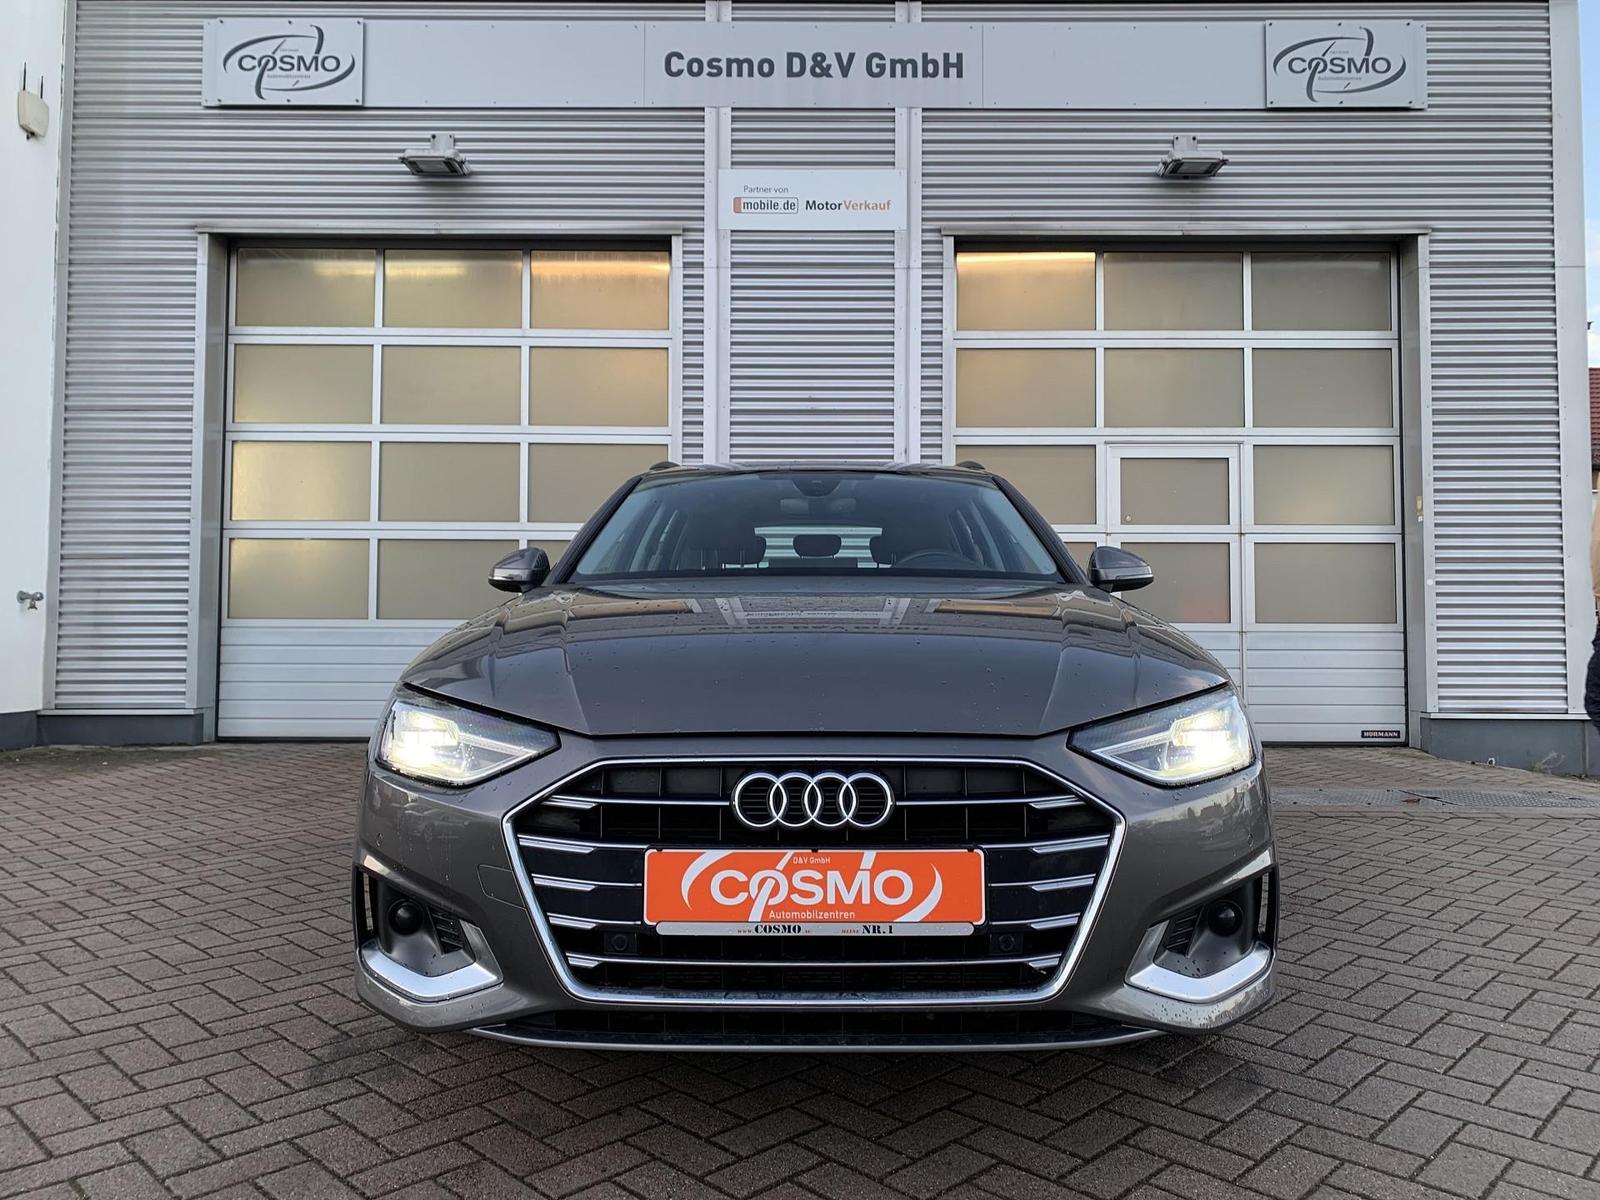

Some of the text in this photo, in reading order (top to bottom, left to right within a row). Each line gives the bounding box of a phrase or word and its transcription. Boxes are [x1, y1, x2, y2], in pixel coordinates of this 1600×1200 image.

[237, 54, 341, 72] COSMO
[664, 51, 964, 79] Cosmo D&V GmbH
[1288, 57, 1391, 74] COSMO
[743, 185, 772, 194] Partner
[742, 199, 796, 211] mobile.de
[792, 856, 831, 864] D&V GmbH
[710, 869, 914, 906] COSMO
[768, 910, 856, 919] Automobilzentren
[862, 924, 893, 934] NR.1
